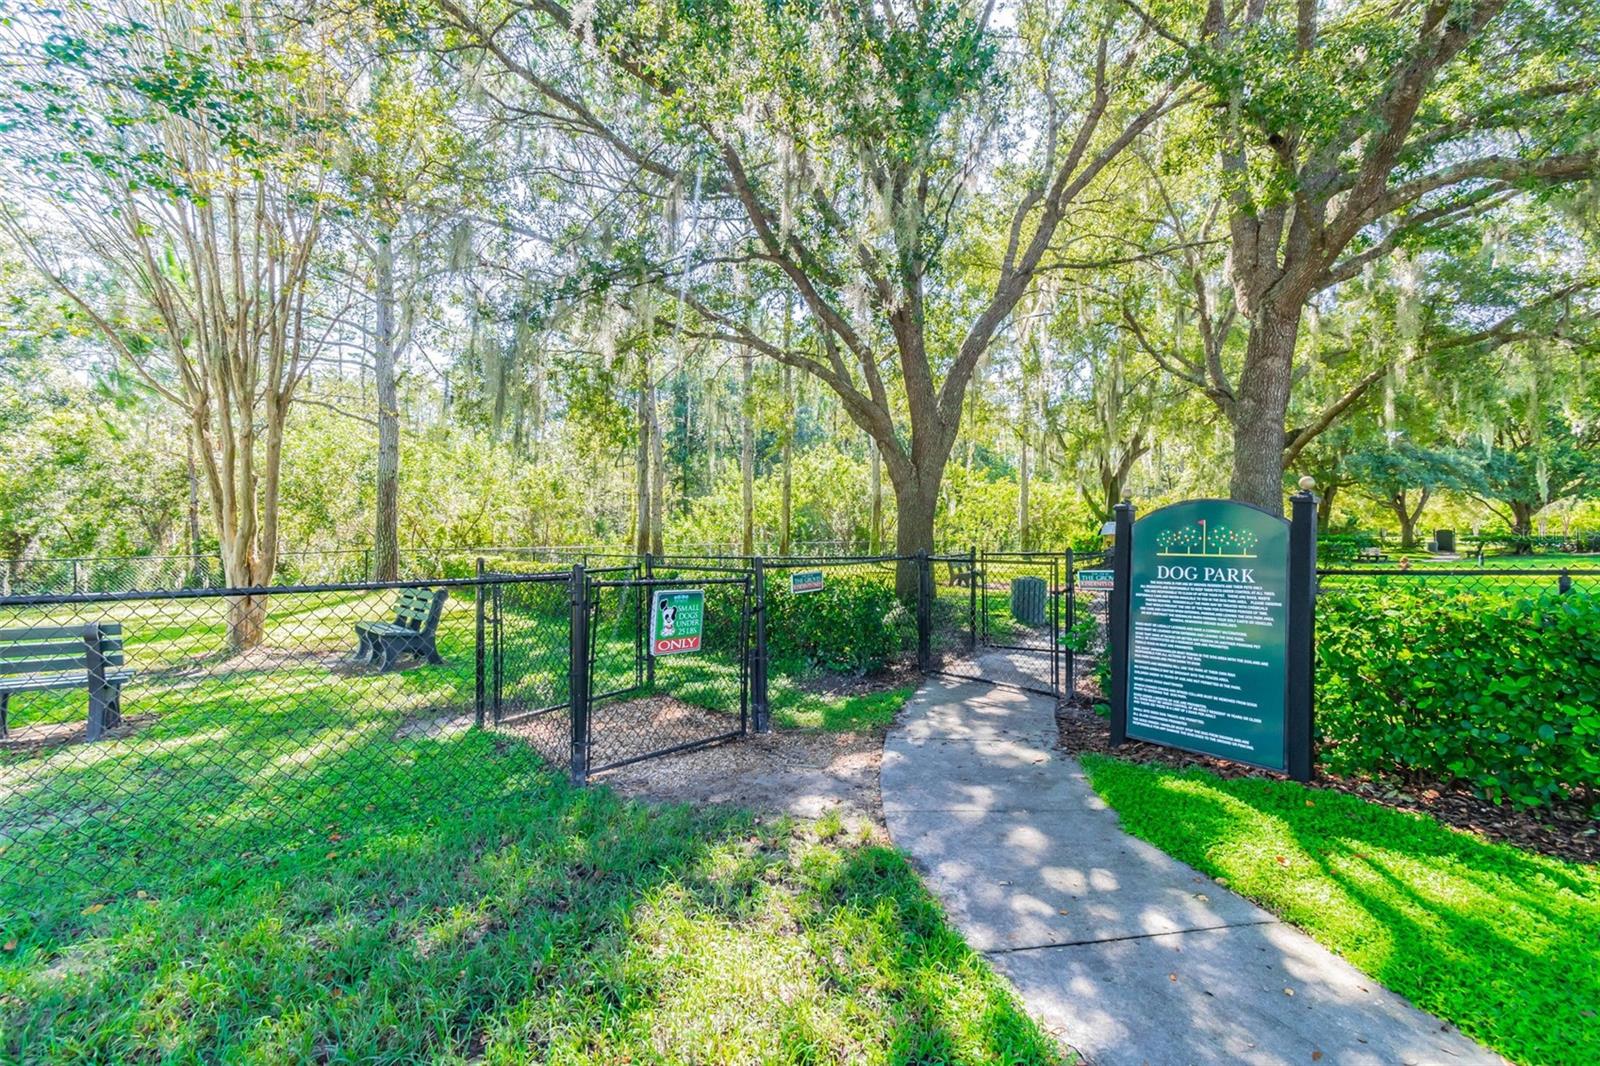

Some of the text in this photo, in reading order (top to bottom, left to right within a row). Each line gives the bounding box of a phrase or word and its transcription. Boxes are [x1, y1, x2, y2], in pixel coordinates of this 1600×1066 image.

[1157, 566, 1256, 583] DOG PARK
[677, 604, 699, 612] SMALL
[679, 612, 698, 620] DOGS
[658, 638, 696, 650] ONLY
